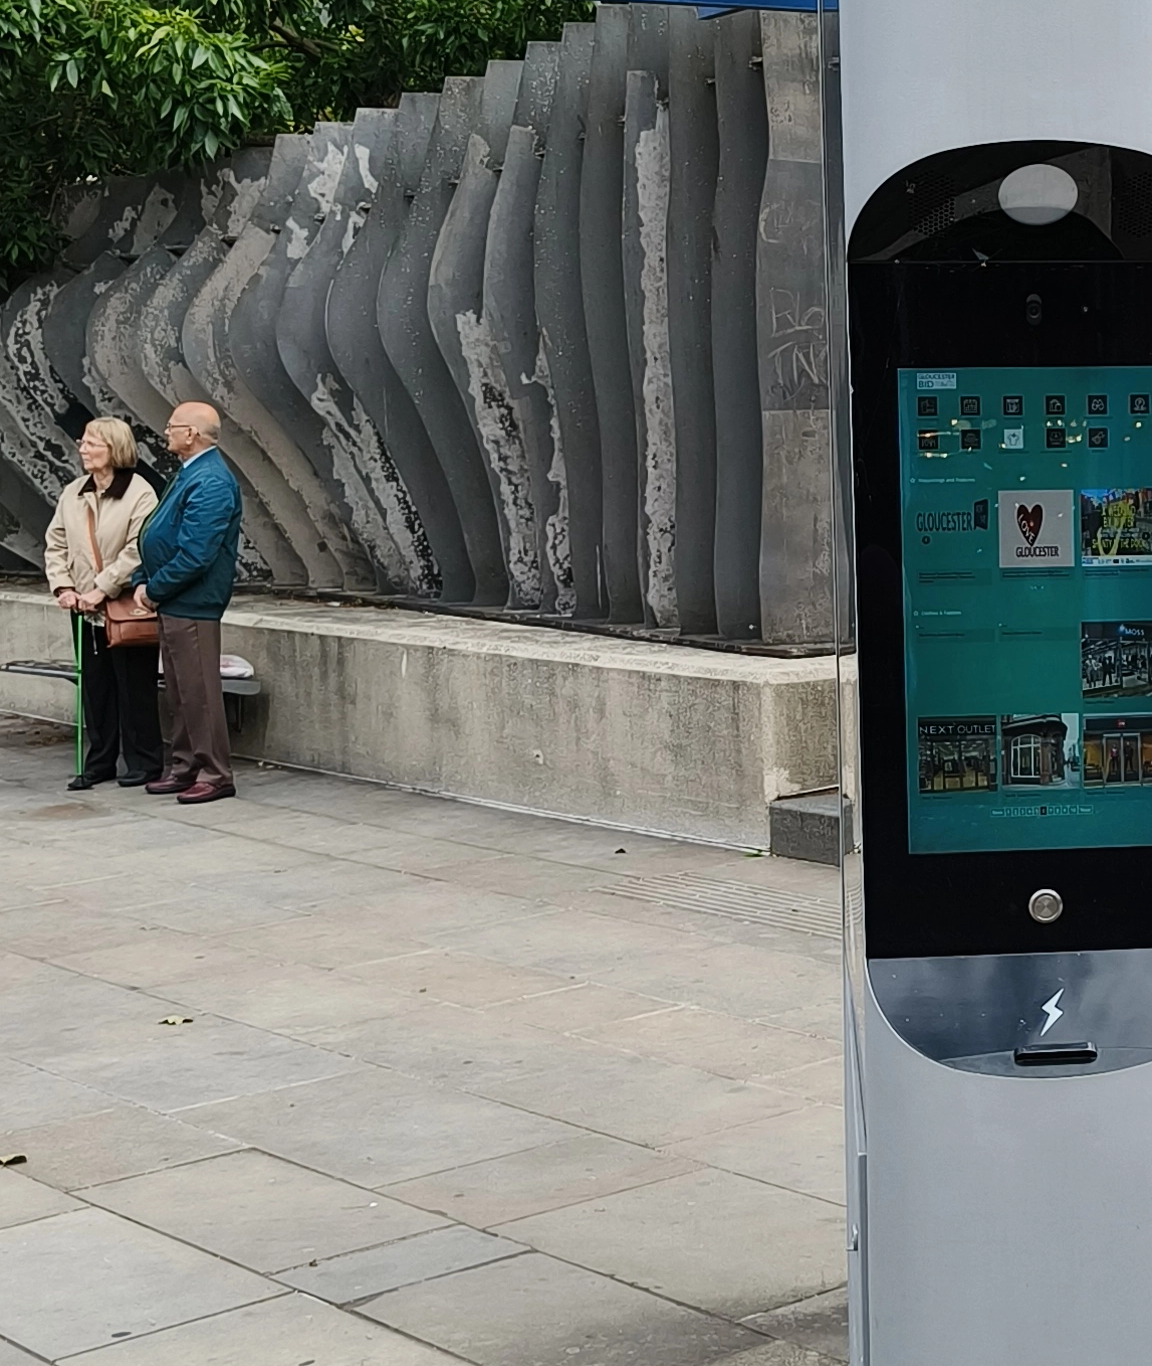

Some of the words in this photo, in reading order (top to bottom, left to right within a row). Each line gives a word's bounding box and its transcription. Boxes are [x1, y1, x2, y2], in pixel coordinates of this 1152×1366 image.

[916, 512, 972, 532] GLOUCESTER
[1017, 513, 1036, 544] LOVE
[1015, 545, 1060, 558] GLOUCESTER
[1124, 628, 1145, 636] MOSS
[919, 725, 955, 735] NEXT
[956, 724, 996, 734] OUTLET
